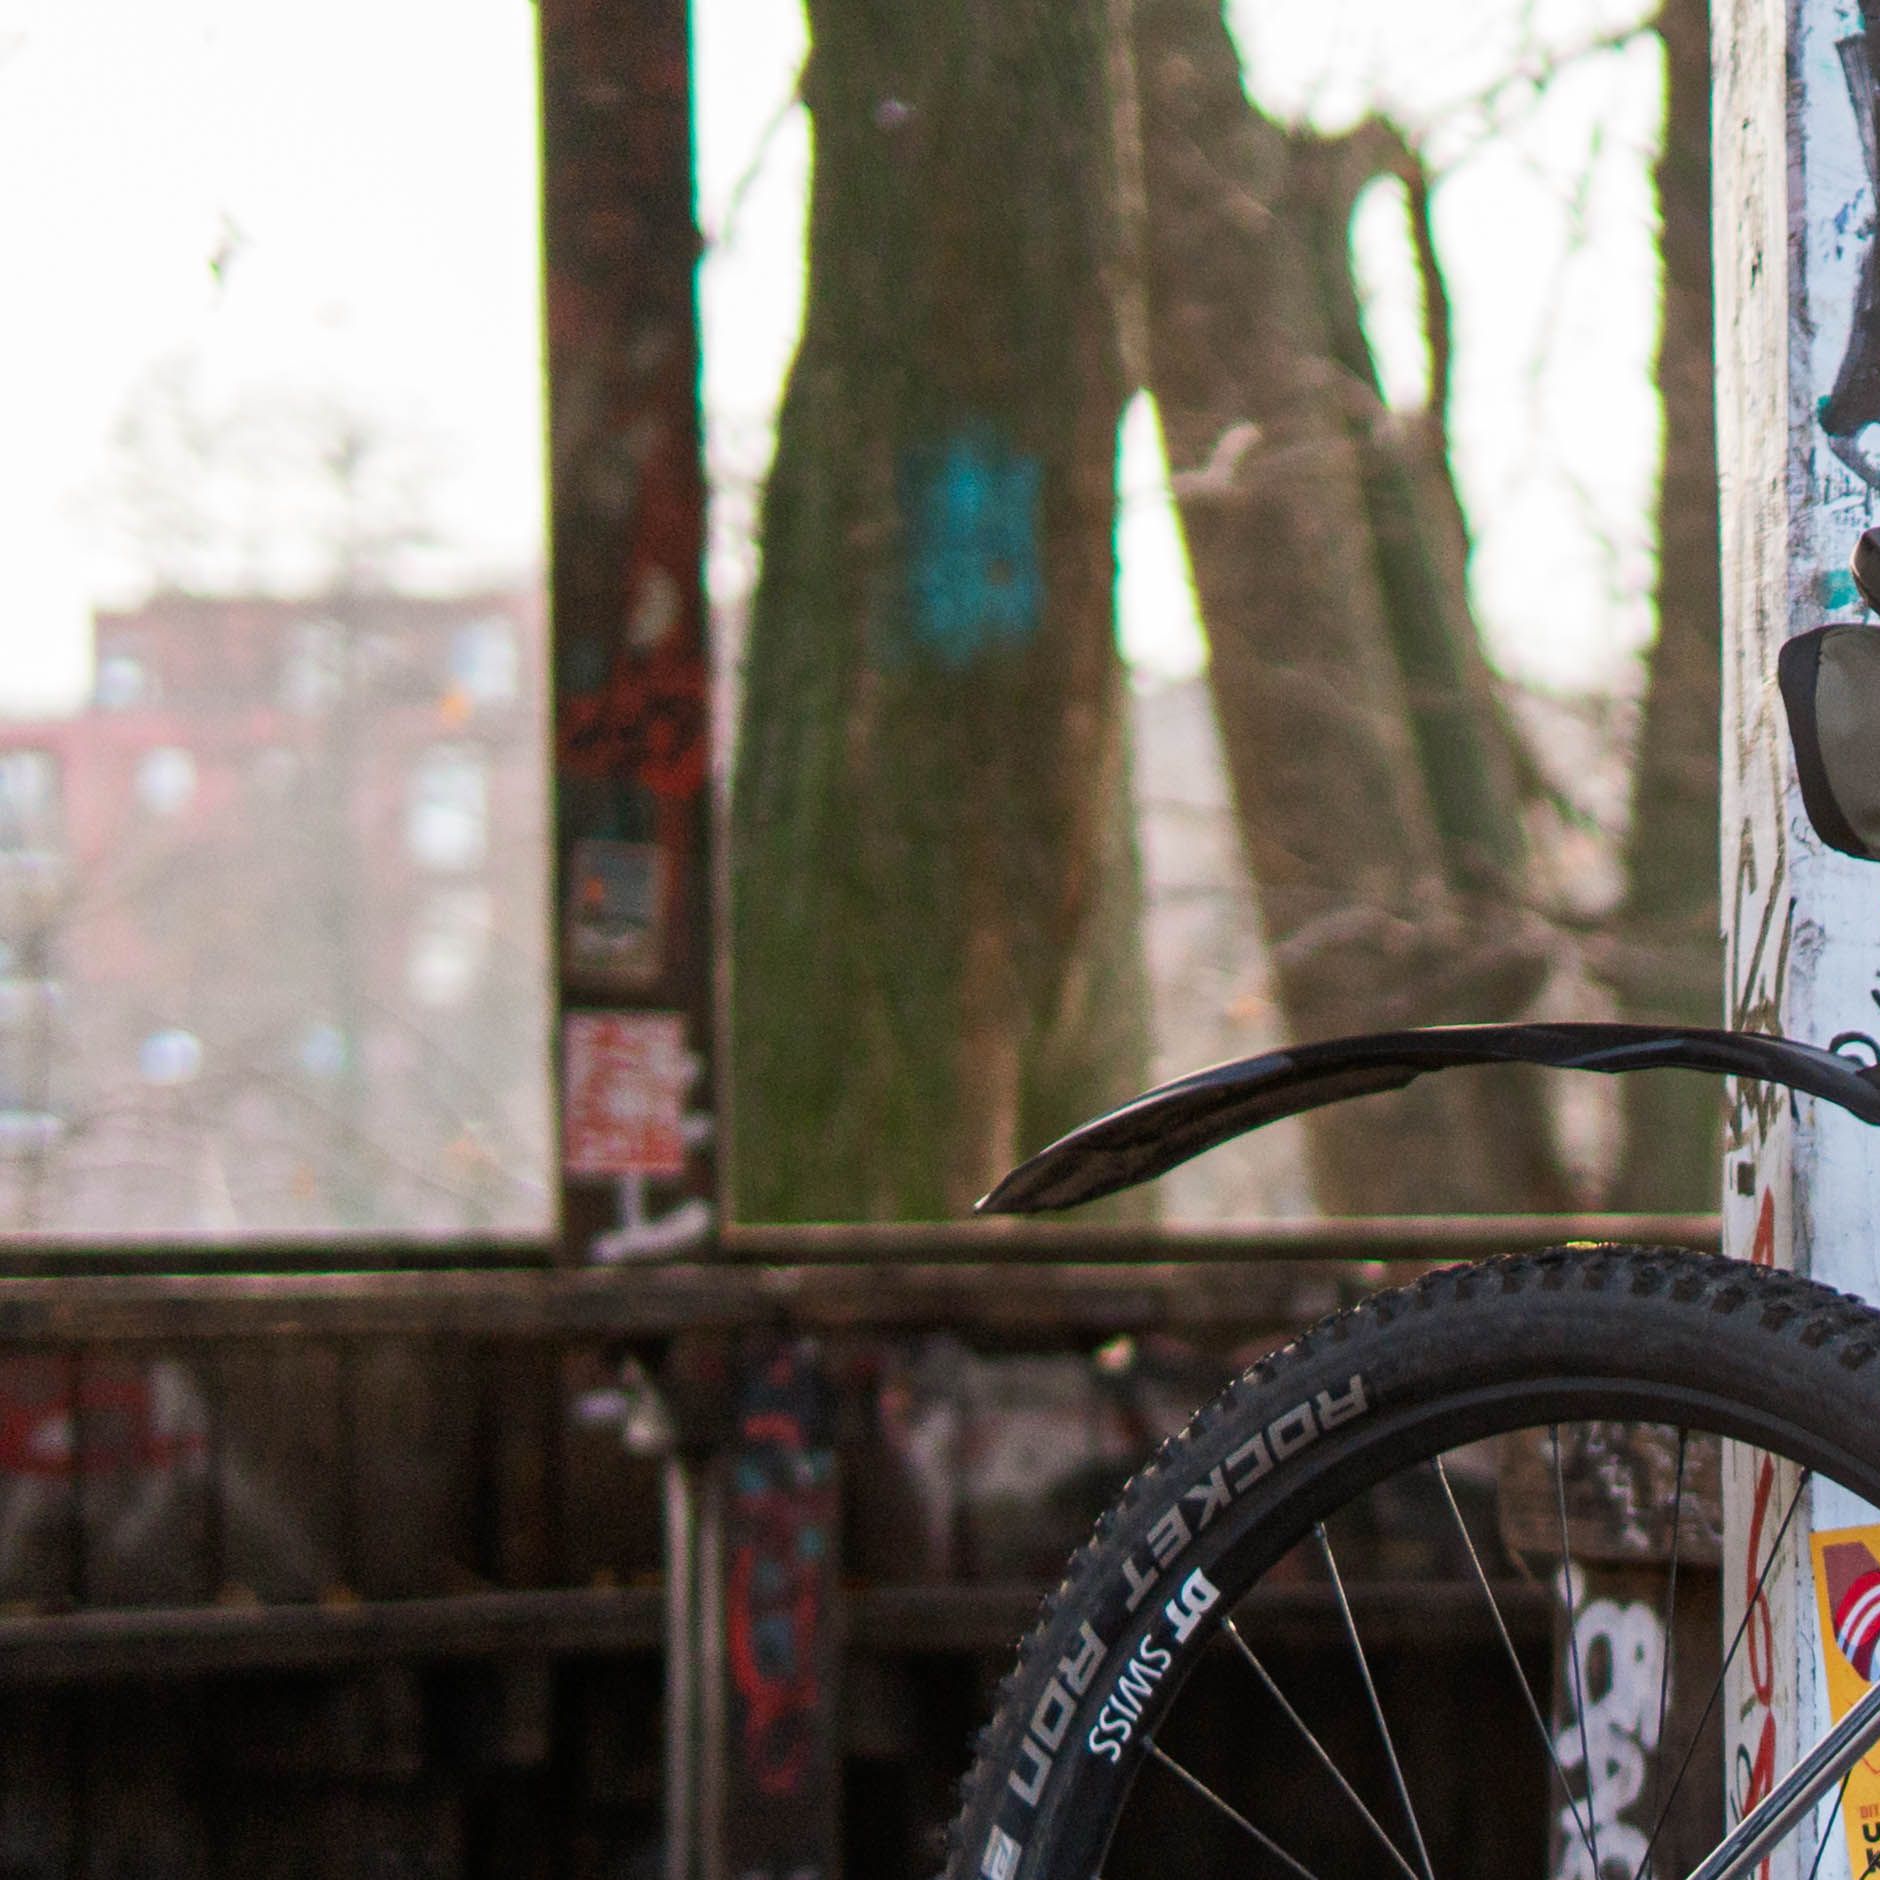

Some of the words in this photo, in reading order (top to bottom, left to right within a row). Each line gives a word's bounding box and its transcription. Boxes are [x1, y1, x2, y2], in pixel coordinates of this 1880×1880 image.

[1120, 1373, 1369, 1612] ROCKET
[1165, 1566, 1221, 1645] DT
[1009, 1620, 1112, 1806] RON
[1088, 1633, 1173, 1766] SWISS
